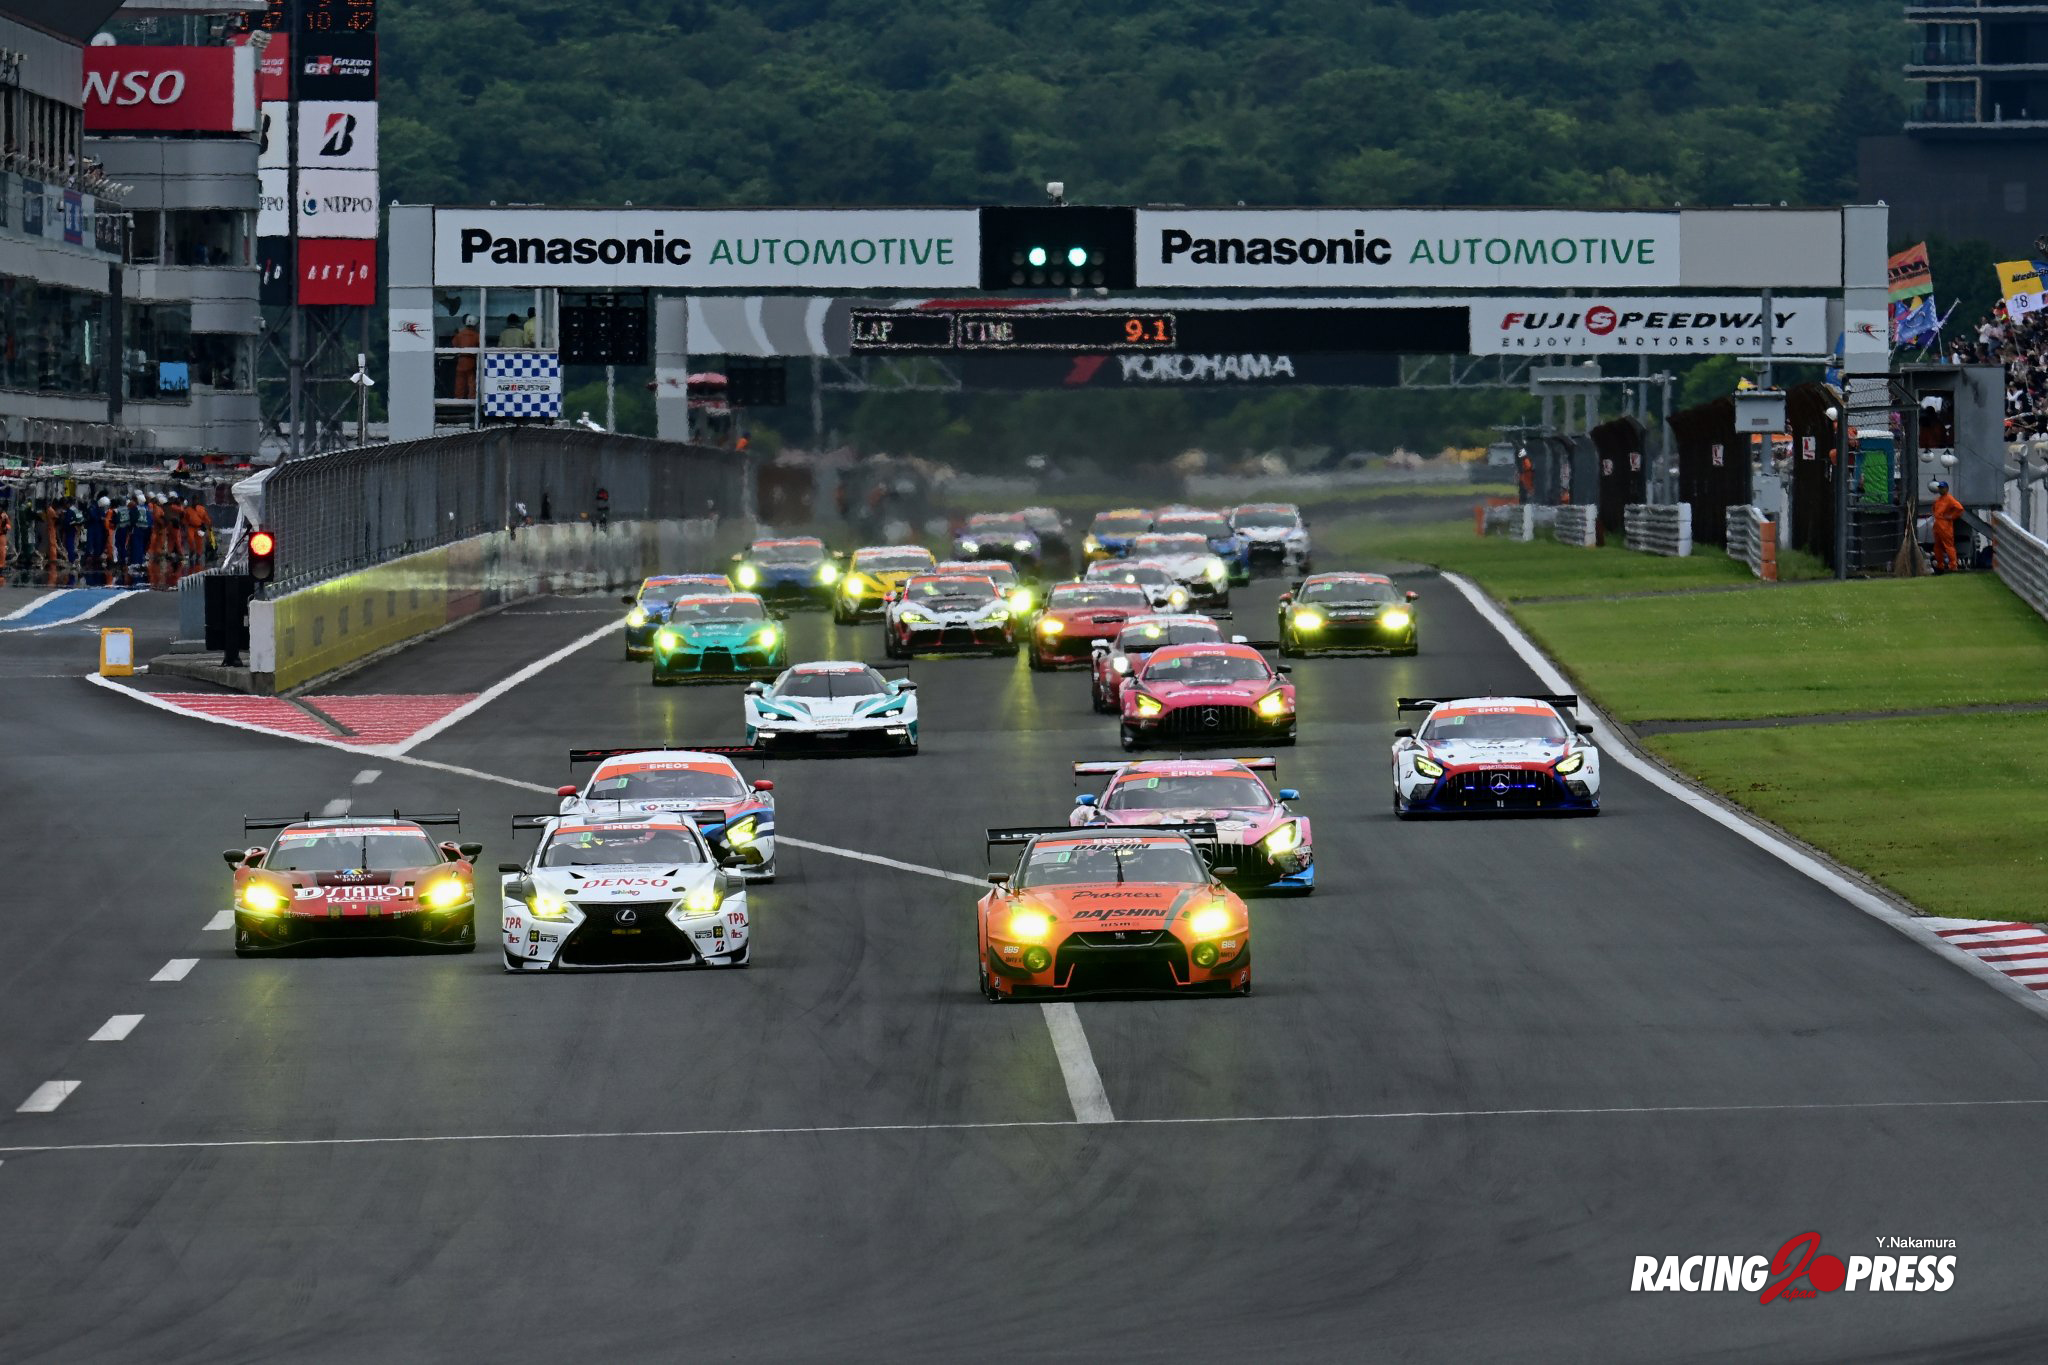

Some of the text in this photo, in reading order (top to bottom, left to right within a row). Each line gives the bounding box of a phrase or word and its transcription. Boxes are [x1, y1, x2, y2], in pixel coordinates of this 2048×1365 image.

[323, 195, 374, 213] NIPPO
[461, 228, 953, 266] Panasonic AUTOMOTIVE
[1161, 228, 1656, 266] Panasonic AUTOMOTIVE
[1500, 312, 1581, 331] FUJI
[1125, 319, 1169, 343] 9.1
[1501, 337, 1587, 347] ENJOY!
[1117, 353, 1296, 382] YOKOHAMA
[603, 823, 650, 831] ENEOS
[582, 878, 668, 889] DENSO
[727, 913, 746, 925] TPR
[1072, 908, 1168, 921] DAISHIN
[505, 917, 522, 929] TPR
